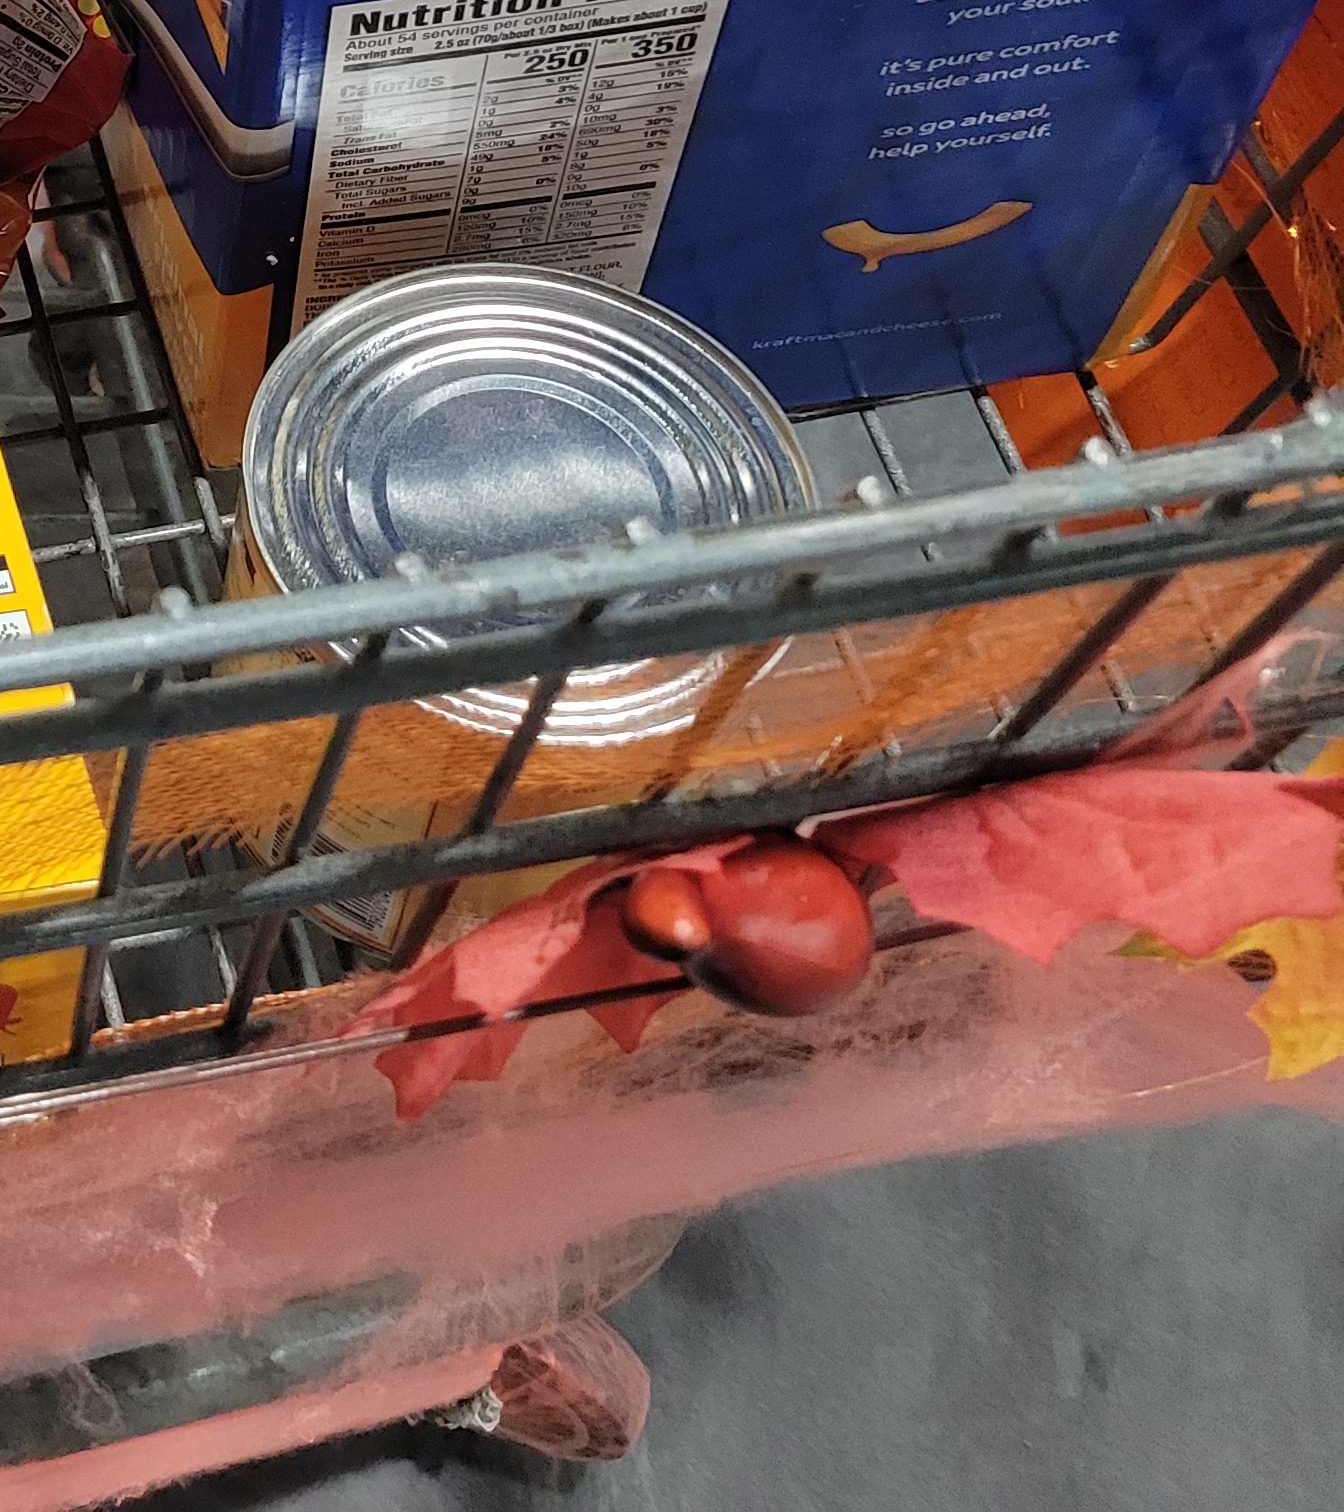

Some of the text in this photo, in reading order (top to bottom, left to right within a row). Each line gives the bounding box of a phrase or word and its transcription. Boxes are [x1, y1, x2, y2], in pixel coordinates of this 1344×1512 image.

[345, 5, 599, 51] About 54 servings container
[946, 0, 1015, 25] your
[523, 48, 589, 75] 250
[631, 32, 698, 59] 350
[879, 30, 1120, 78] it's pure comfort
[885, 56, 1091, 97] inside and out.
[880, 103, 1052, 139] so go ahead,
[867, 123, 1052, 161] help yourself.
[751, 309, 1003, 351] kraftmacandcheese.com
